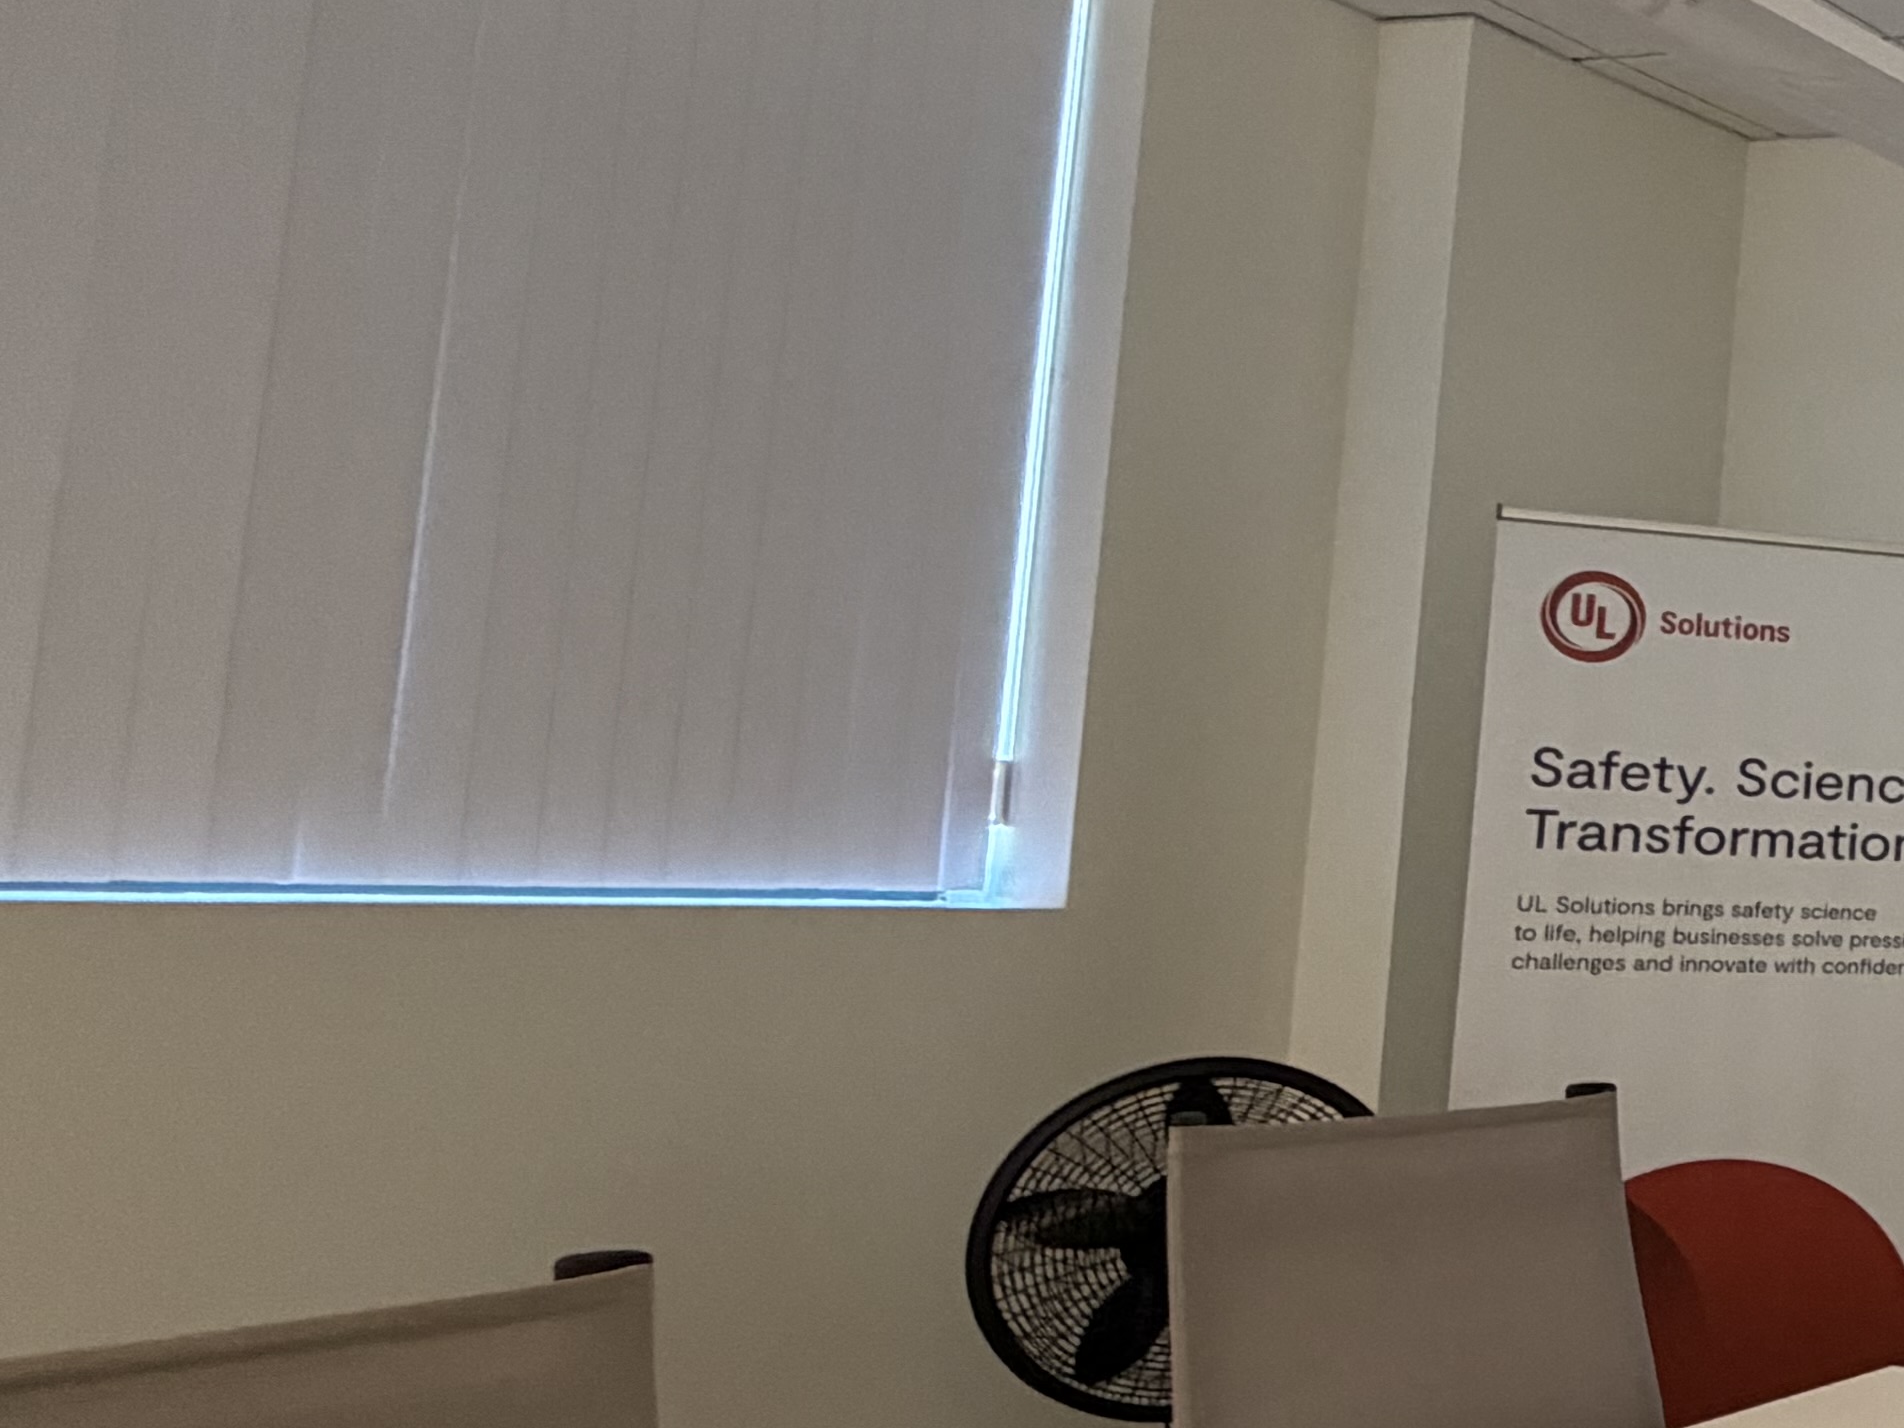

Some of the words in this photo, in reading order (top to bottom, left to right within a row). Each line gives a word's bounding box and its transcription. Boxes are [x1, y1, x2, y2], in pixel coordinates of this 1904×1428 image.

[1658, 609, 1791, 644] Solutions
[1530, 745, 1716, 804] Safety.
[1516, 895, 1547, 915] UL
[1556, 896, 1655, 917] Solutions
[1662, 898, 1724, 920] brings
[1731, 900, 1795, 923] safety
[1800, 903, 1877, 922] science
[1514, 925, 1537, 942] to
[1544, 924, 1581, 945] life,
[1588, 926, 1665, 948] helping
[1672, 927, 1785, 948] businesses
[1791, 930, 1843, 948] solve
[1511, 953, 1626, 976] challenges
[1633, 954, 1673, 973] and
[1679, 956, 1767, 975] innovate
[1774, 957, 1816, 975] with
